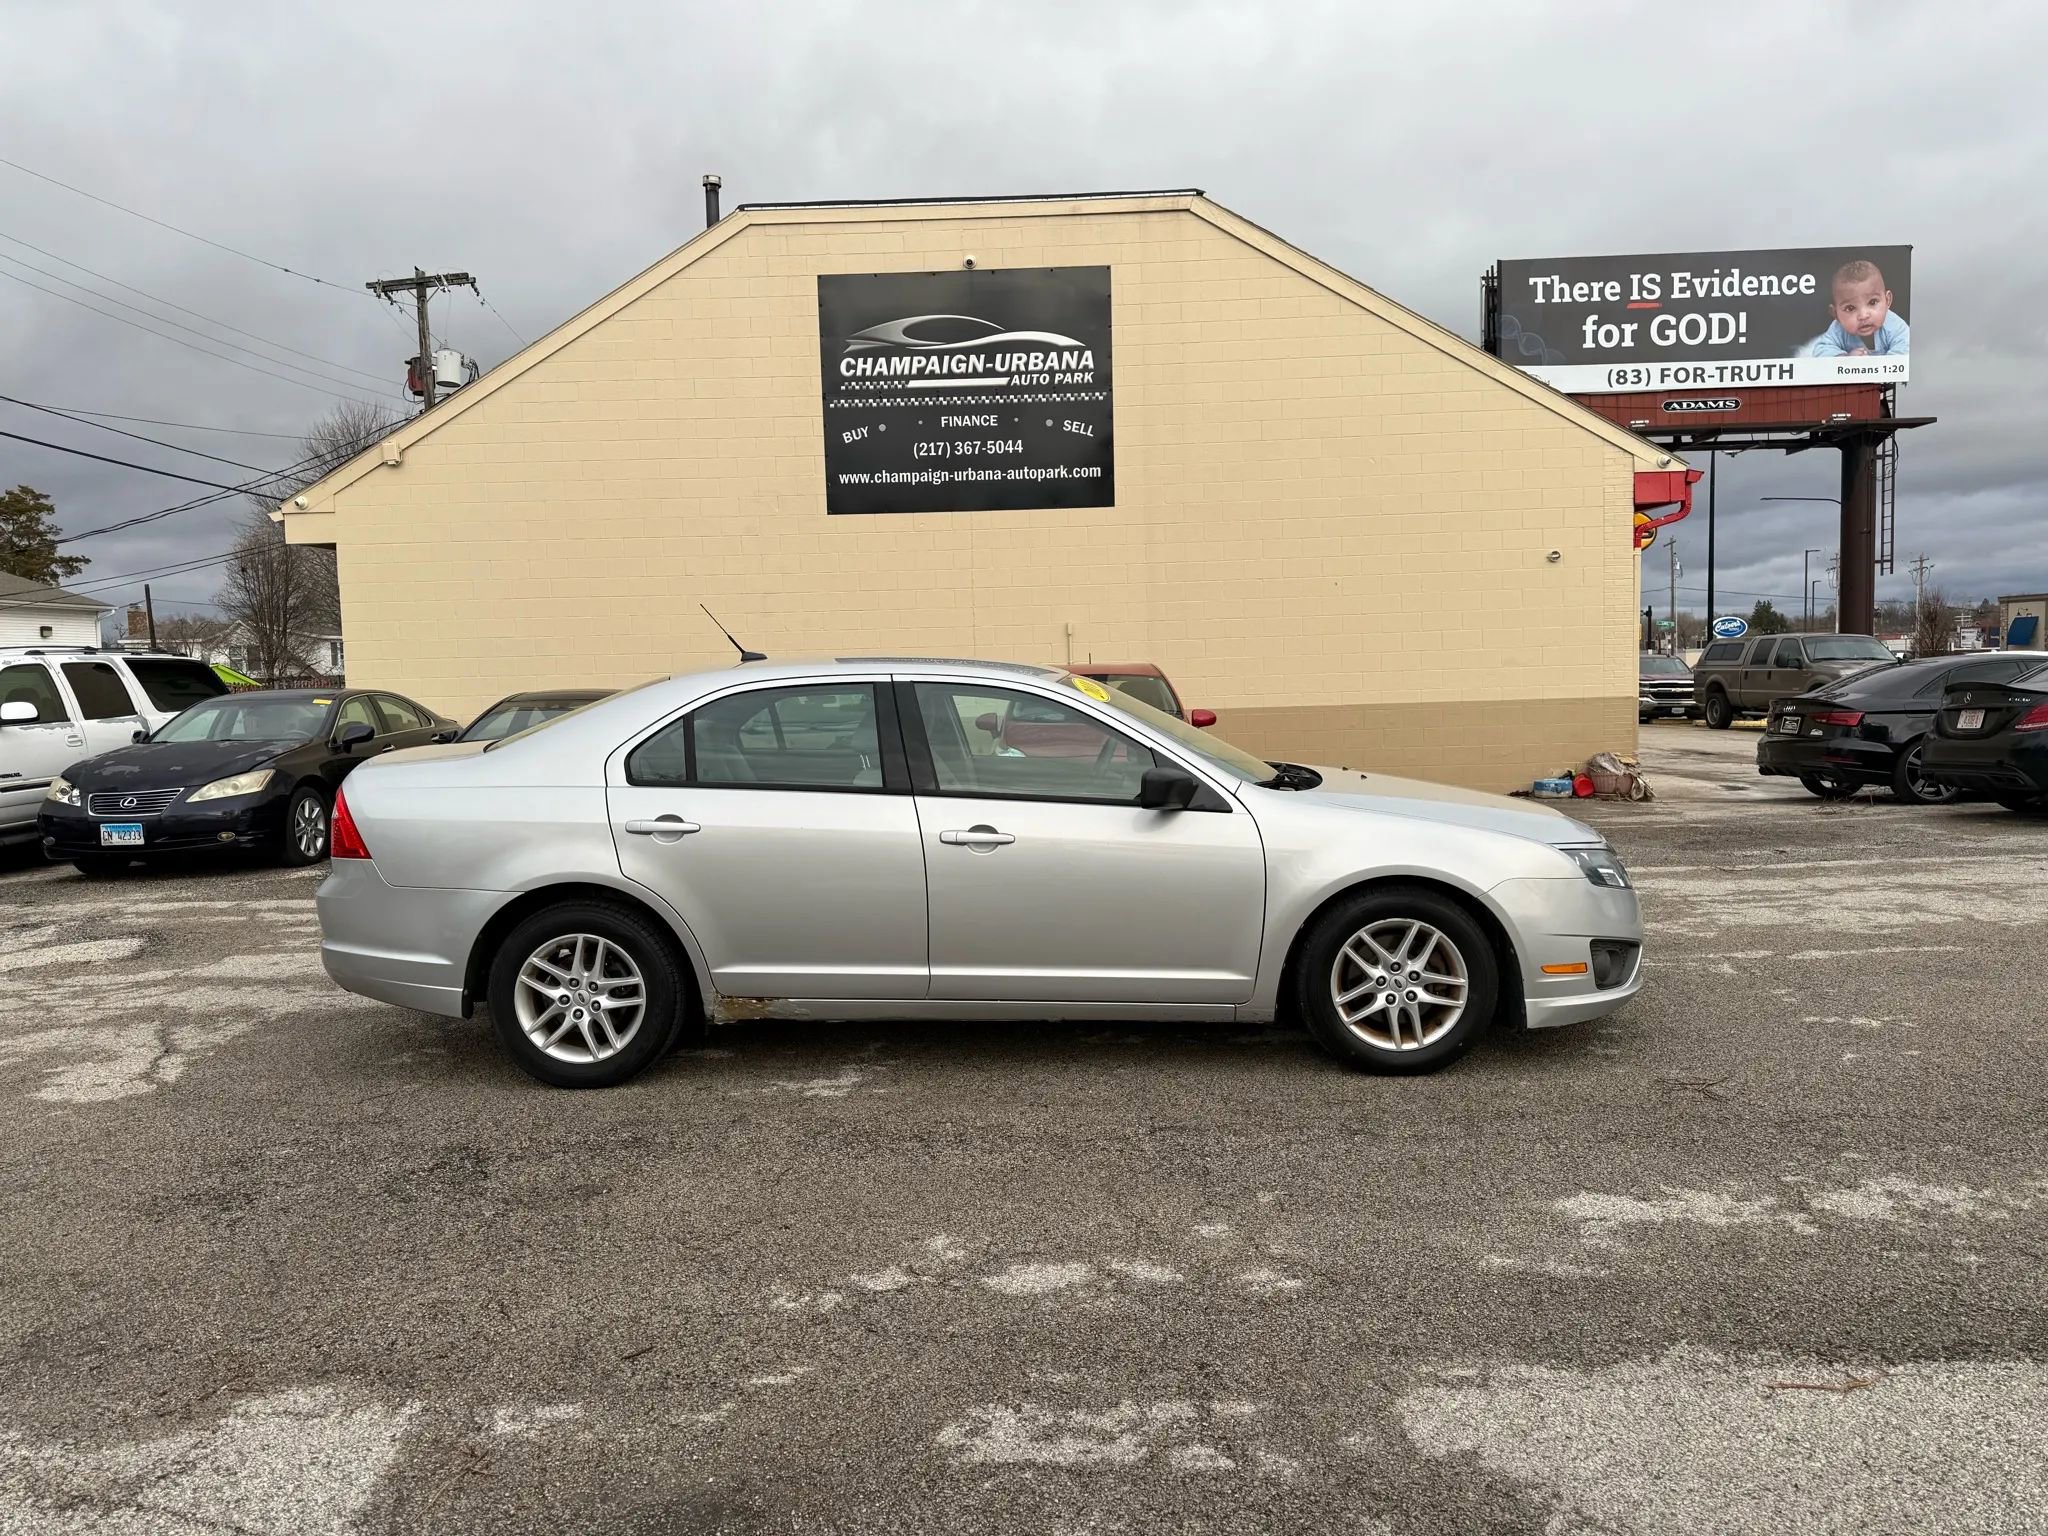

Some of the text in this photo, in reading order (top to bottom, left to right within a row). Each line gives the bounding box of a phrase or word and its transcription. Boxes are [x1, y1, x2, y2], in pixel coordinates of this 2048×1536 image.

[1528, 268, 1816, 303] There IS Evidence
[1582, 311, 1748, 349] for GOD!
[840, 350, 1094, 377] CHAMPAIGN-URBANA
[1837, 365, 1905, 375] Romans 1:20
[1010, 371, 1094, 387] AUTO PARK
[1607, 363, 1795, 388] (83) FOR-TRUTH
[1668, 399, 1737, 410] ADAMS
[842, 414, 1095, 444] BUY FINANCE SELL
[913, 439, 1024, 459] (217) 367-5044
[839, 465, 1102, 486] www.champaign-urbana-autopark.com
